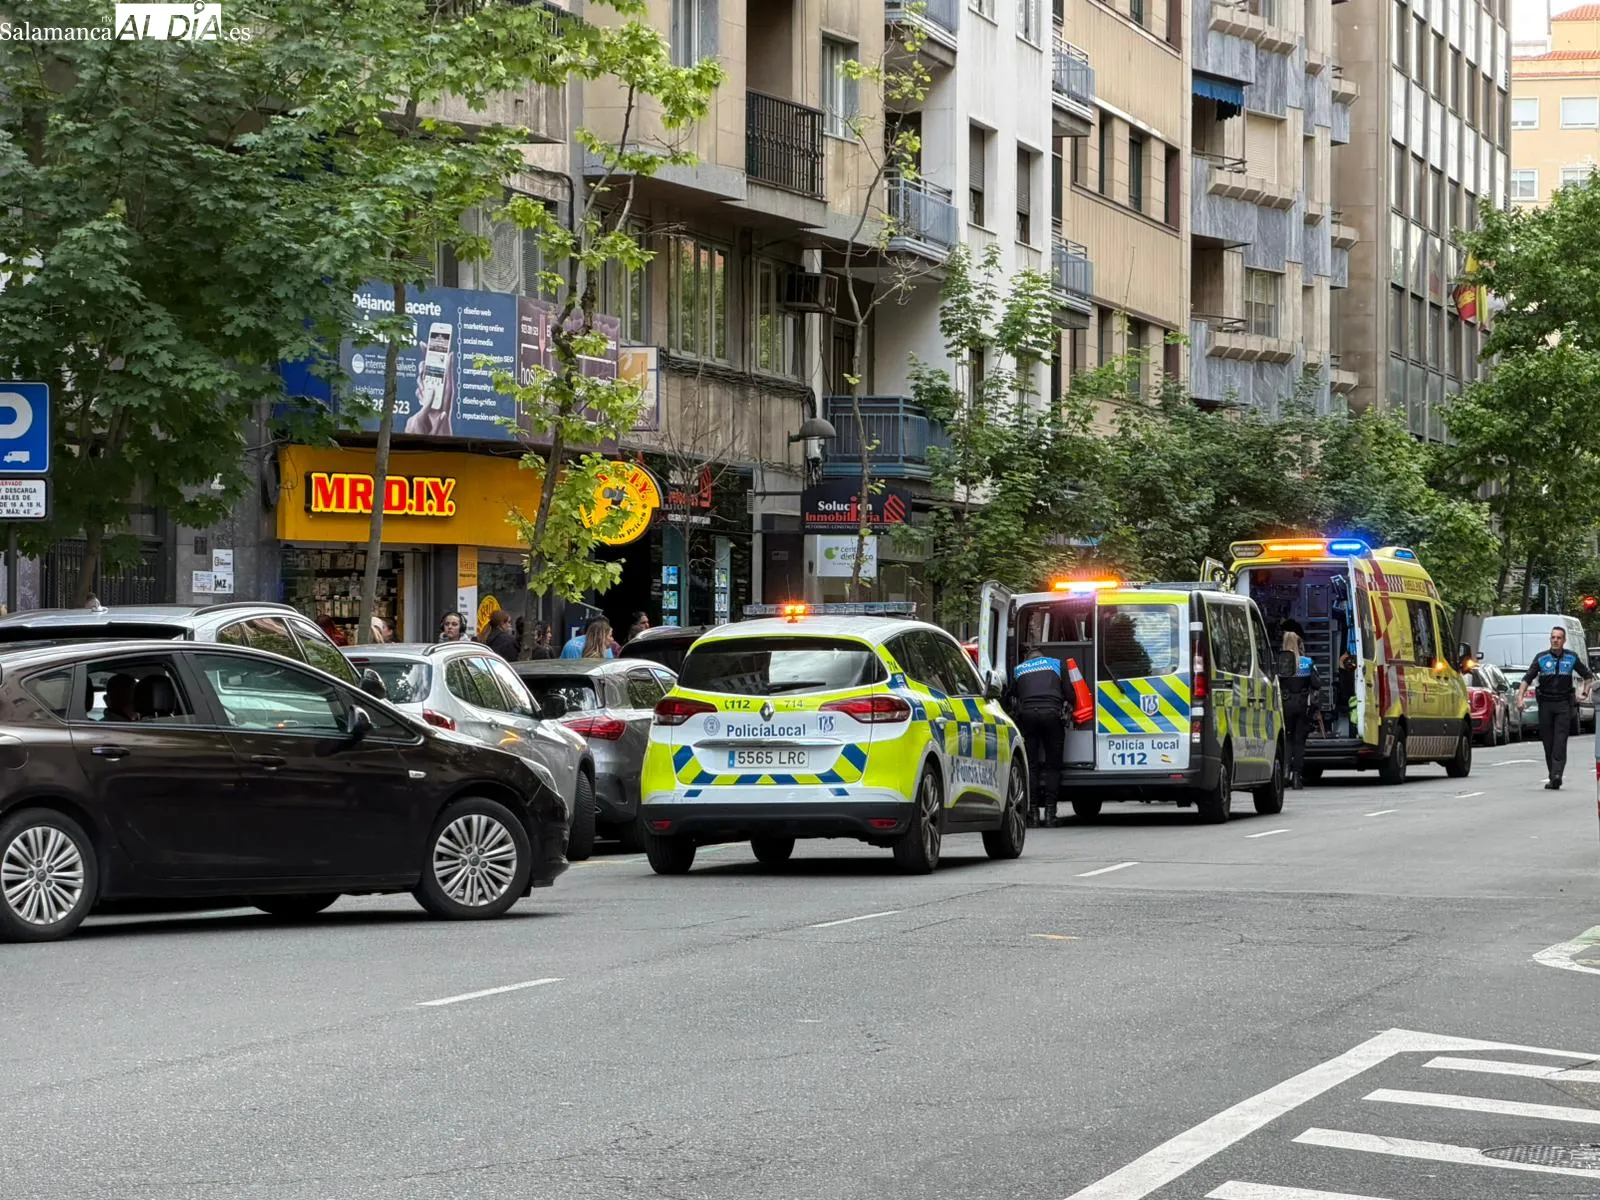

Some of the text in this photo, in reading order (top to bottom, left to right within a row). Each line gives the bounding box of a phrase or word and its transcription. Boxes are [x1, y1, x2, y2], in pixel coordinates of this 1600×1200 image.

[404, 301, 442, 317] acerte
[480, 309, 492, 317] web
[463, 323, 504, 333] marketing online
[463, 337, 494, 347] social media
[503, 355, 514, 363] SEO
[463, 383, 490, 393] community
[730, 699, 750, 709] 112
[784, 699, 803, 708] 714
[726, 723, 806, 737] PolicíaLocal
[1108, 739, 1180, 751] Policía Local
[738, 751, 806, 764] 5565 LRC
[1117, 752, 1148, 766] 112
